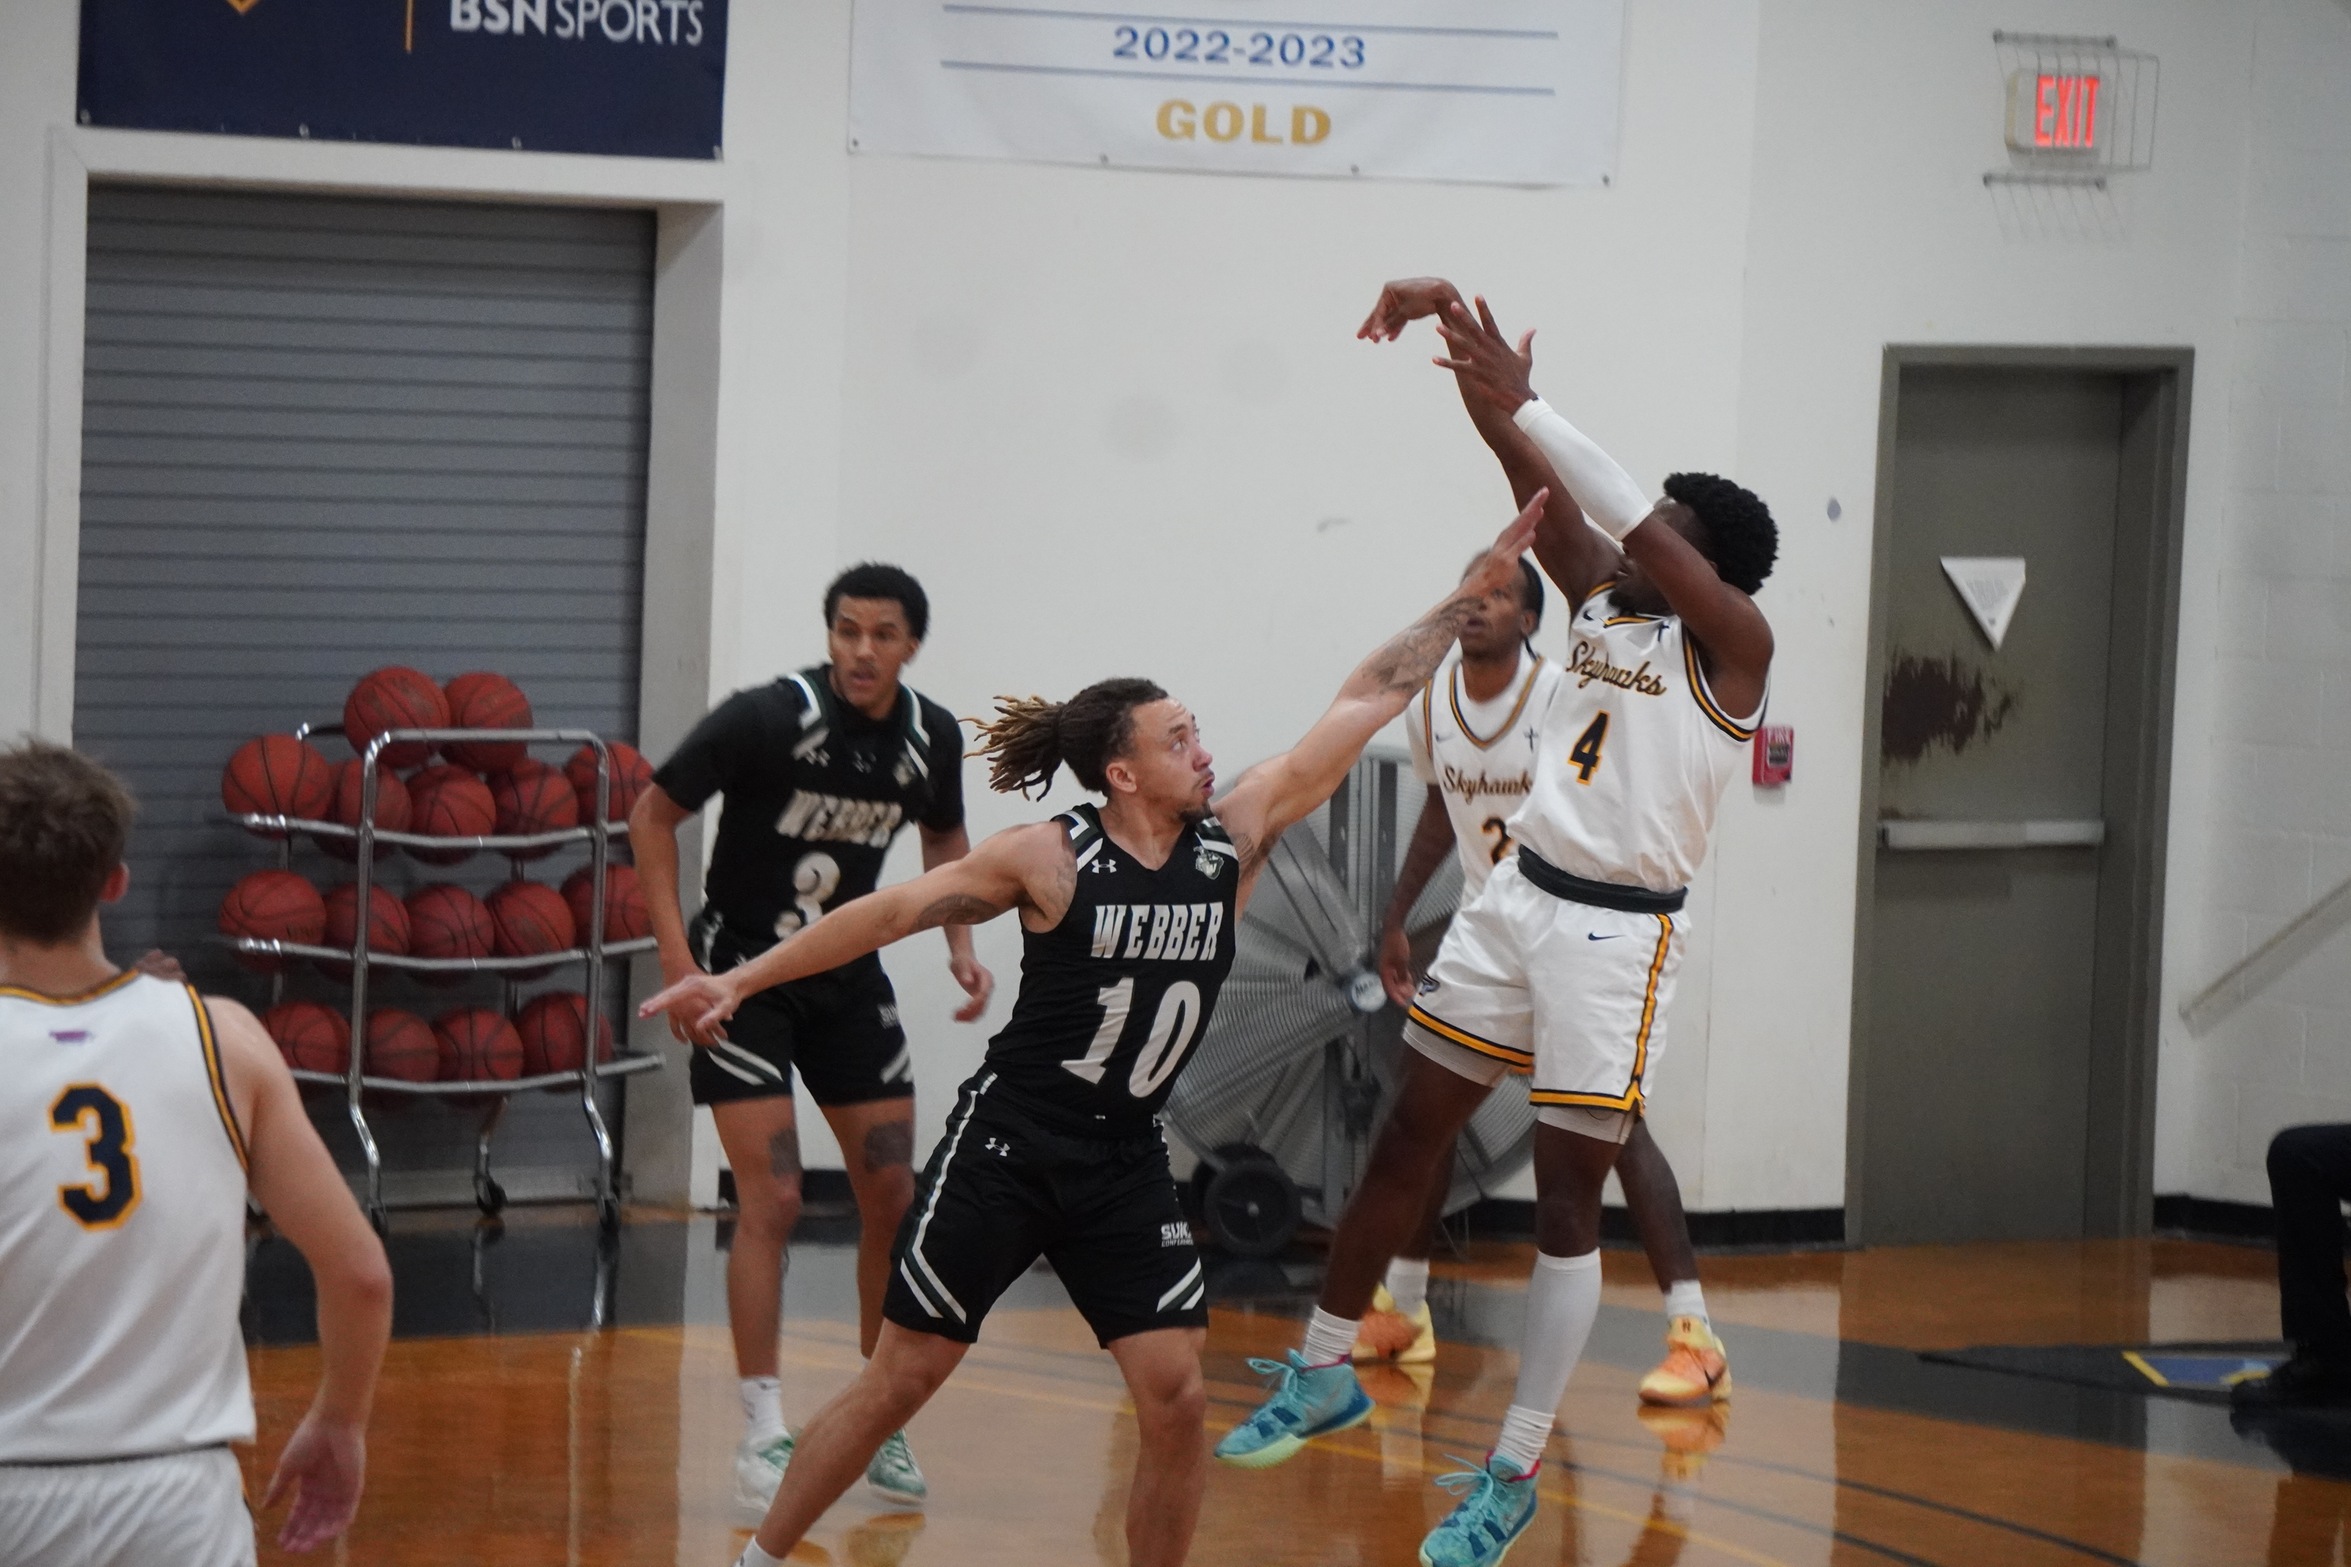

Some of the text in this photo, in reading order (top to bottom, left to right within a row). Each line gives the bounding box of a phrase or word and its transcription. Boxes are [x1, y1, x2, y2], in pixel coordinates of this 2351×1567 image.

[450, 0, 704, 46] BSN SPORTS
[1112, 25, 1366, 69] 2022-2023
[1155, 98, 1332, 145] GOLD
[2034, 73, 2102, 149] EXIT
[1568, 709, 1610, 785] 4
[1443, 764, 1533, 805] Skyhawk
[1090, 902, 1224, 961] WEBBER
[1060, 976, 1201, 1098] 10
[47, 1082, 143, 1232] 3
